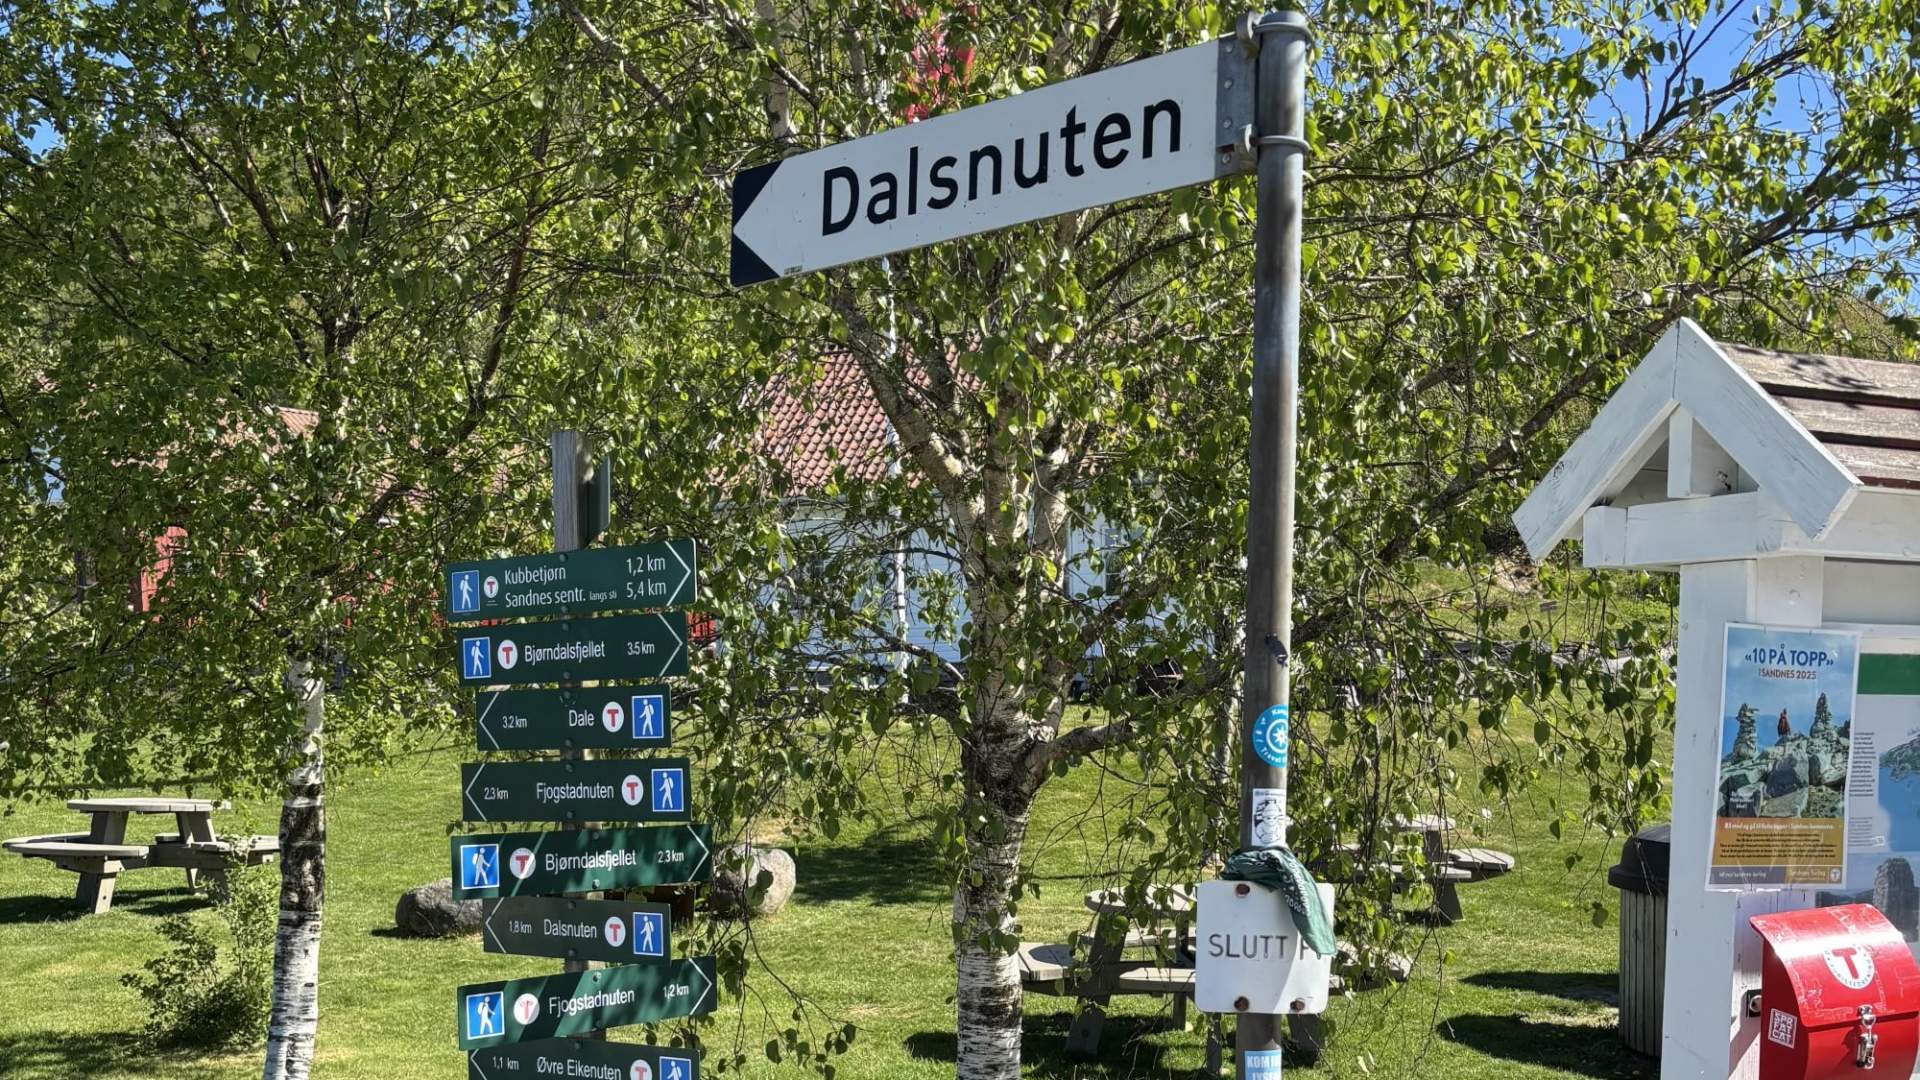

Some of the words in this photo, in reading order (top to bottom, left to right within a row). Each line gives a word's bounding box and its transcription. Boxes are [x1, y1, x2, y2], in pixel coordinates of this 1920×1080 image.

[822, 98, 1182, 236] Dalsnuten
[626, 556, 644, 575] 1,2
[647, 554, 666, 571] km
[504, 567, 566, 585] Kubbetjørn
[505, 590, 552, 608] Sandnes
[554, 587, 586, 603] sentr.
[589, 591, 608, 602] langs
[609, 590, 617, 600] sti
[626, 581, 645, 600] 5,4
[647, 579, 667, 596] km
[524, 641, 606, 666] Bjørndalsfjellet
[641, 641, 655, 655] km
[1768, 643, 1787, 665] PÅ
[1789, 649, 1834, 667] TOPP»
[1761, 668, 1795, 679] SANDNES
[1796, 671, 1817, 680] 2025
[516, 715, 528, 729] km
[568, 708, 595, 727] Dale
[496, 787, 509, 800] km
[536, 780, 615, 803] Fjogstadnuten
[545, 849, 637, 876] Bjørndalsfjellet
[671, 848, 685, 862] km
[520, 921, 533, 934] km
[543, 917, 598, 939] Dalsnuten
[1207, 932, 1289, 960] SLUTT
[663, 984, 676, 999] 1,2
[676, 983, 690, 997] km
[548, 989, 636, 1015] Fjogstadnuten
[492, 1057, 505, 1070] 1,1
[507, 1057, 520, 1071] km
[536, 1056, 565, 1075] Øvre
[567, 1059, 622, 1080] Eikenuten
